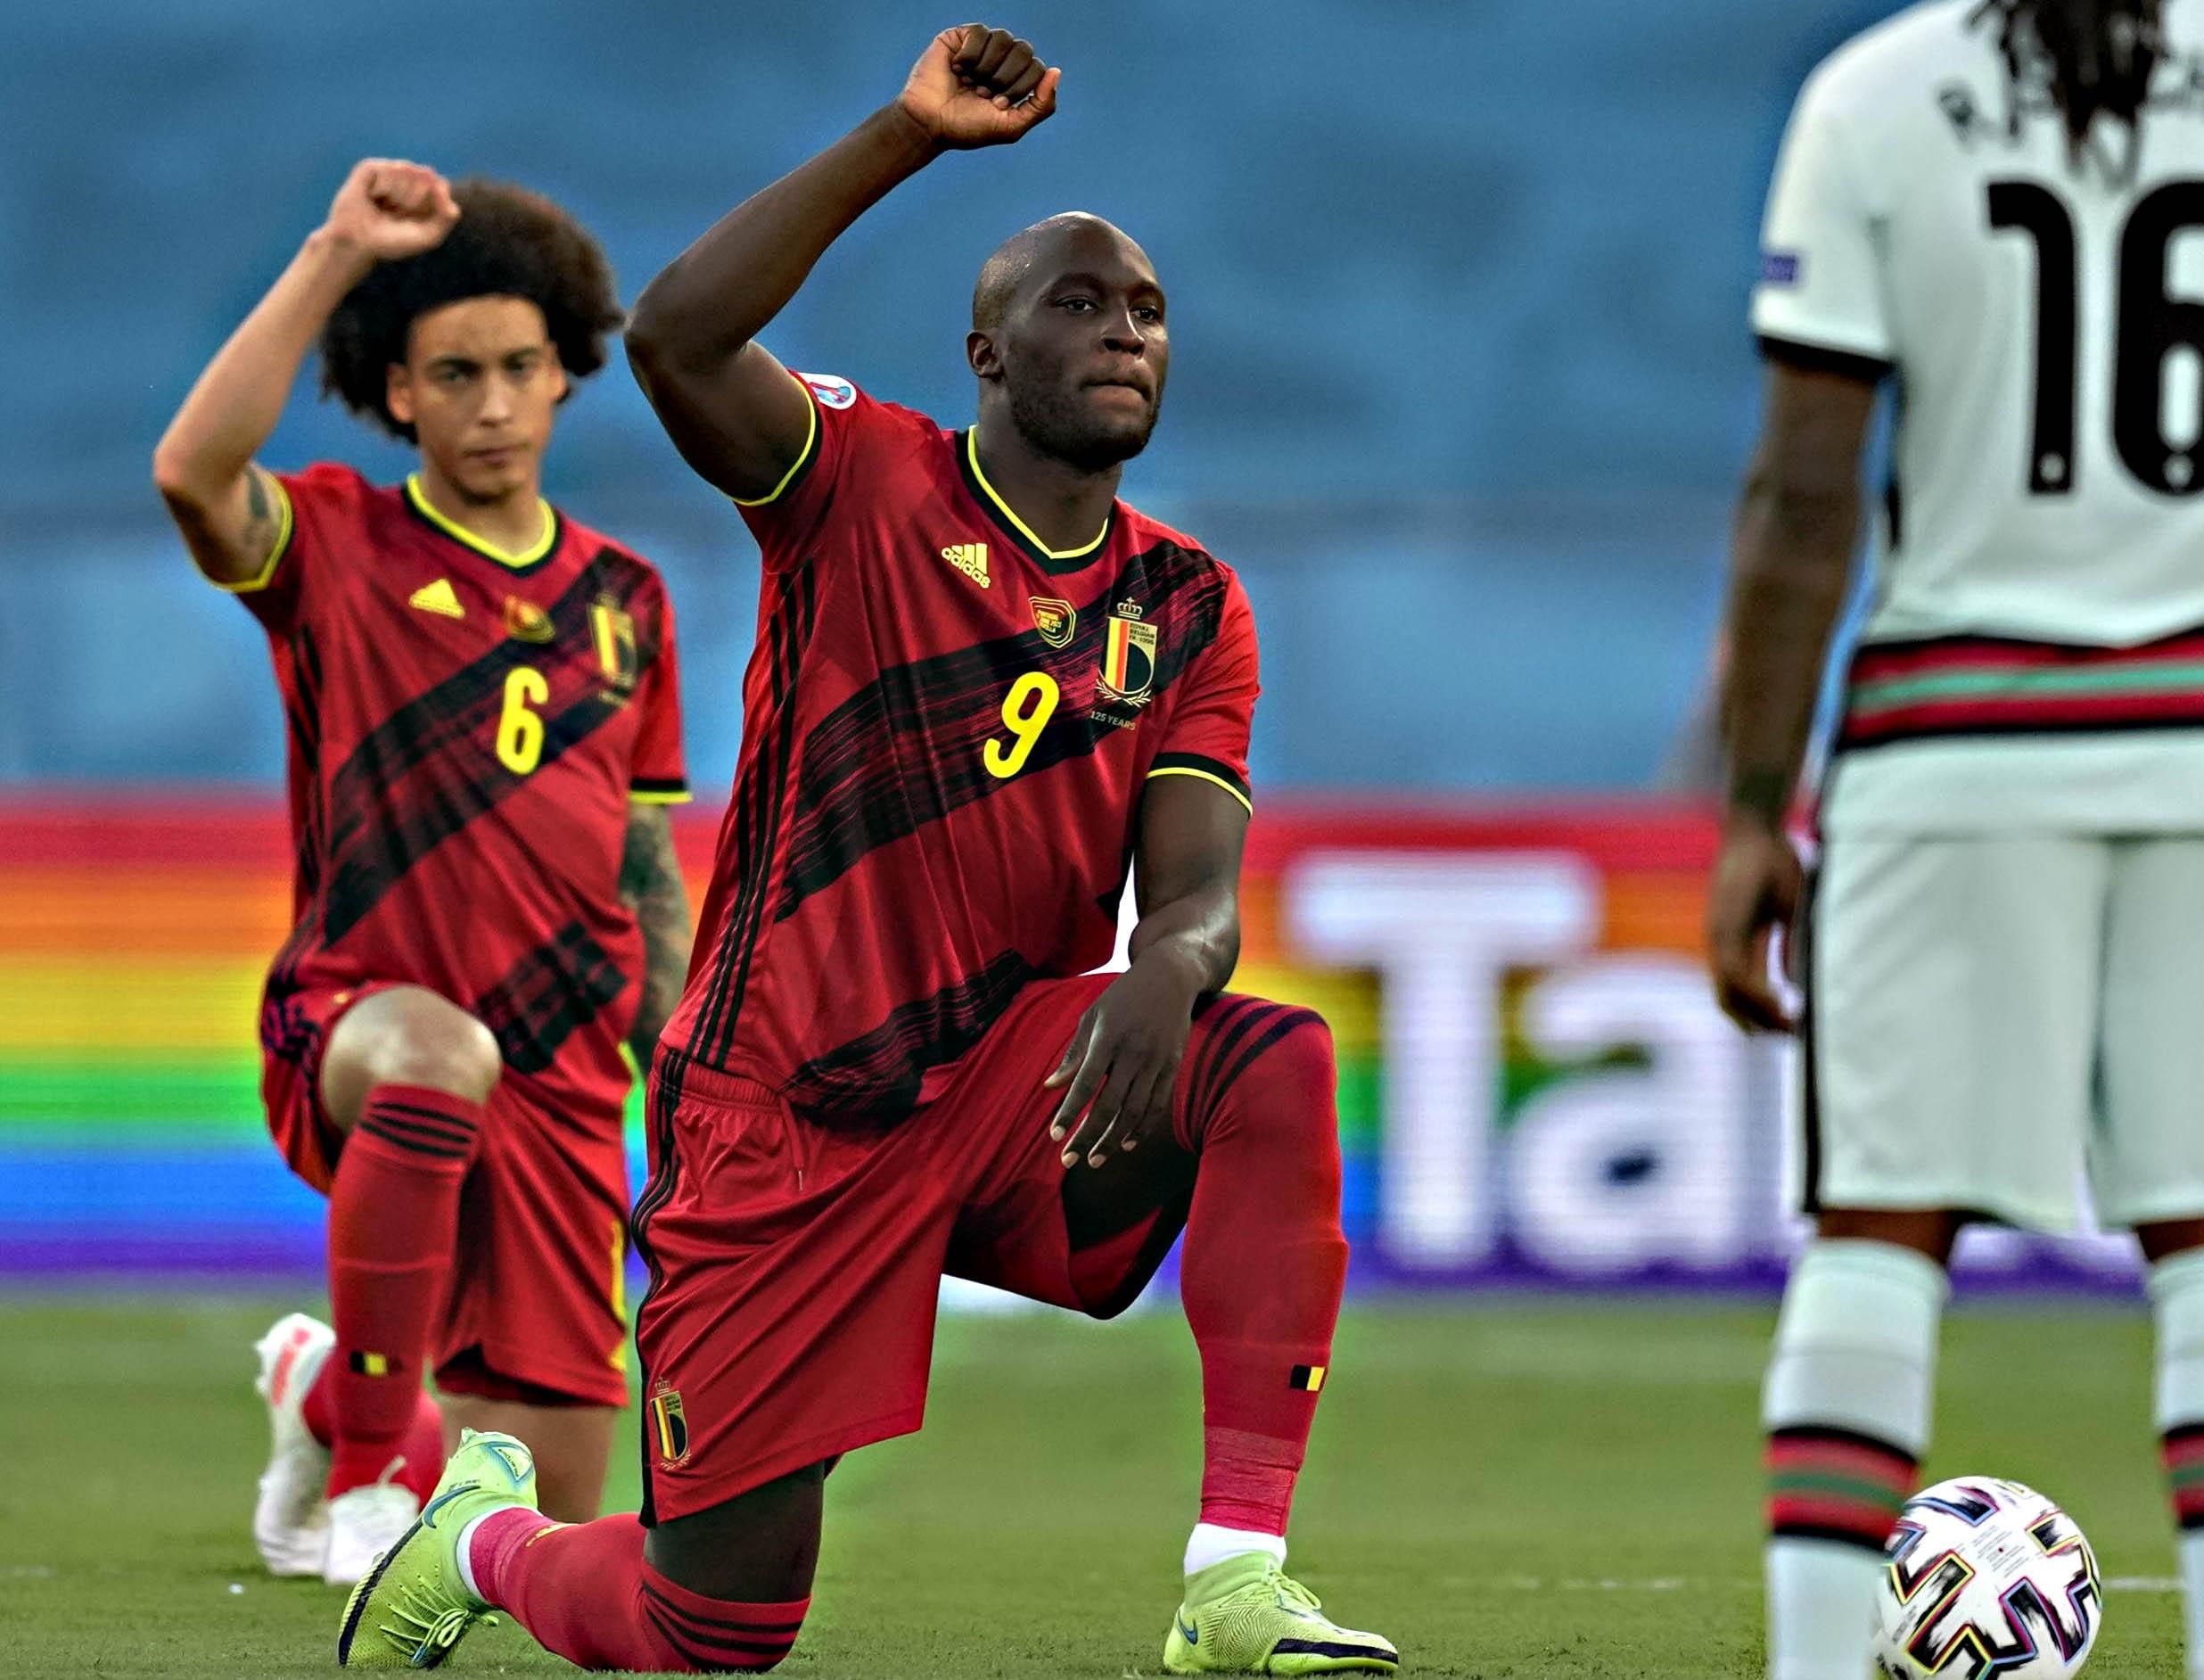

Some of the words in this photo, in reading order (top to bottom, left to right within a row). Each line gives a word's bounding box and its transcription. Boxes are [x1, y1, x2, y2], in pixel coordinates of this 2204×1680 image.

[1986, 178, 2204, 497] 16
[942, 547, 991, 589] adidas
[496, 666, 549, 775] 6
[983, 671, 1059, 778] 9
[1090, 711, 1106, 722] 125
[1107, 714, 1136, 730] YEARS
[1284, 849, 1810, 1266] Ta
